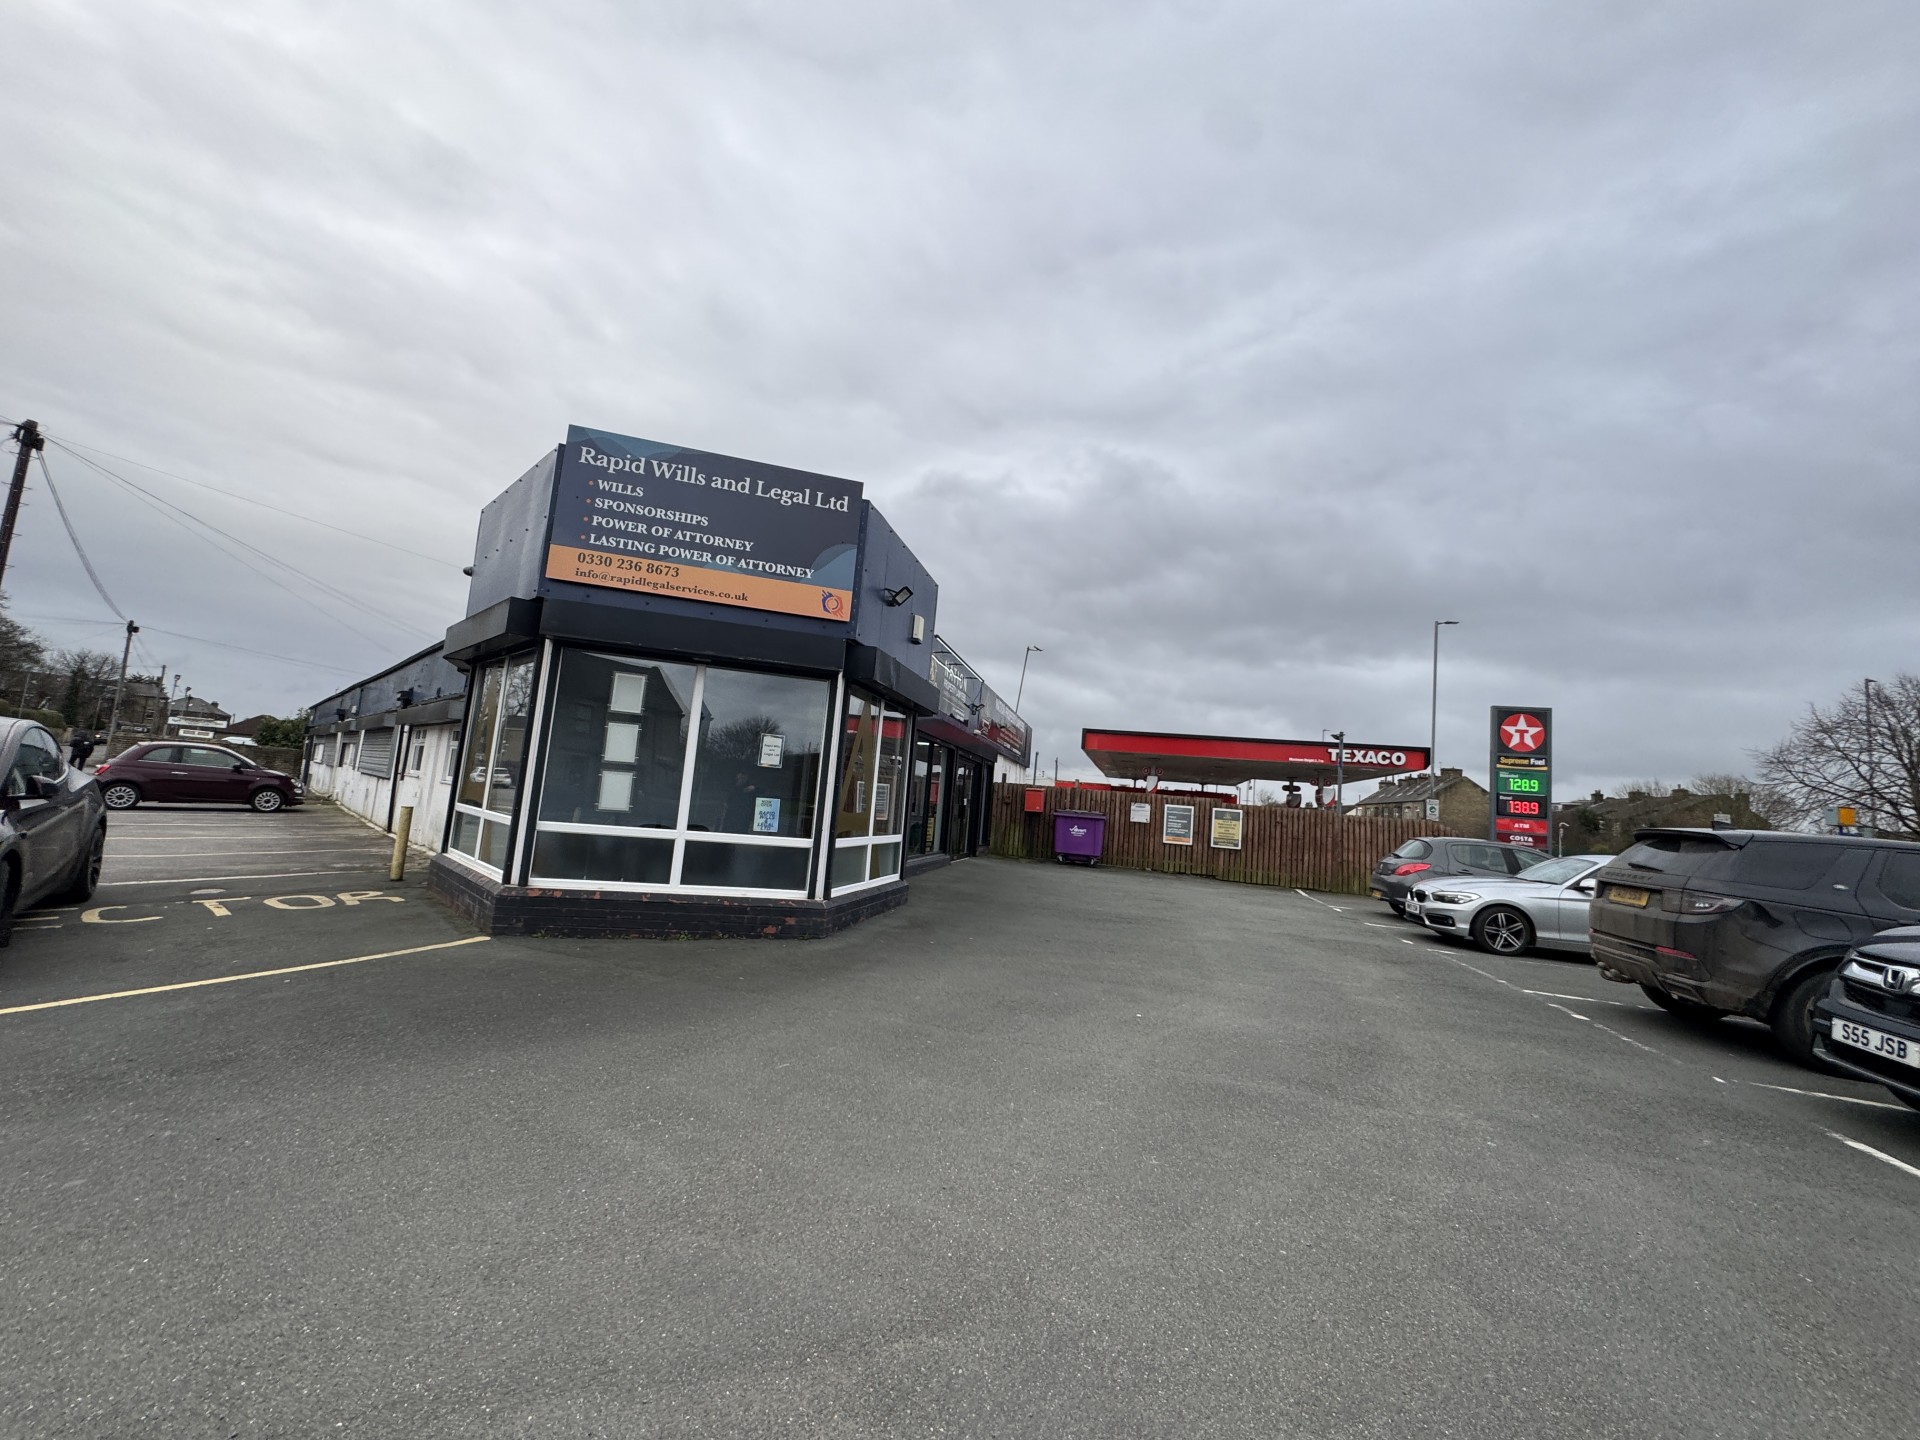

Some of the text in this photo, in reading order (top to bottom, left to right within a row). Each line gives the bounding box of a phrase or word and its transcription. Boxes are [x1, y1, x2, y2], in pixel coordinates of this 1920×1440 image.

[578, 446, 849, 512] Rapid Wills and Legal Ltd
[597, 479, 644, 497] WILLS
[594, 497, 709, 527] SPONSORSHIPS
[591, 515, 754, 551] POWER OF ATTORNEY
[577, 552, 680, 578] 0330 236 8673
[589, 533, 815, 579] LASTING POWER OF ATTORNEY
[575, 567, 749, 601] info@rapidlegalservices.co.uk
[1328, 748, 1407, 766] TEXACO
[1500, 756, 1546, 766] Supreme Fuel
[1509, 778, 1539, 792] 128.9
[1509, 800, 1539, 815] 138.9
[1842, 1023, 1908, 1059] S55 JSB
